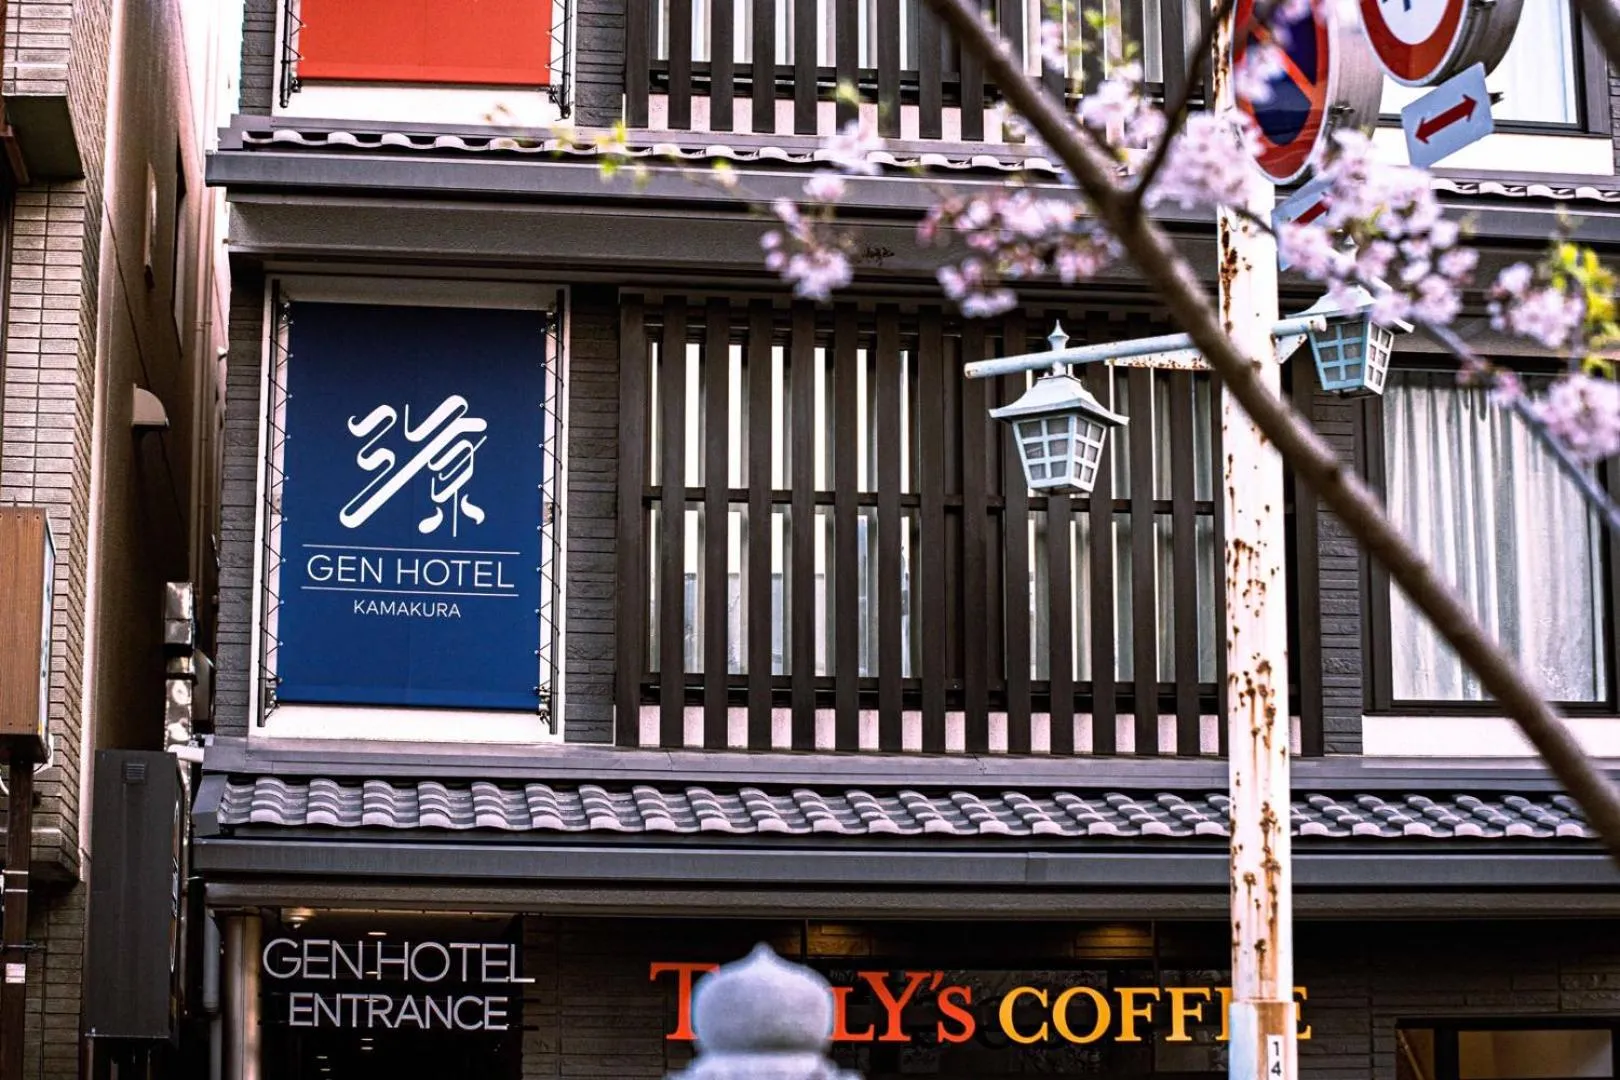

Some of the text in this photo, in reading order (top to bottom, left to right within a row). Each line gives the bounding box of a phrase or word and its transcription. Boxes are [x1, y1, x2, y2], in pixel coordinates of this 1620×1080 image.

[307, 554, 515, 588] GEN HOTEL
[353, 600, 461, 618] KAMAKURA
[262, 938, 536, 983] GEN HOTEL
[289, 992, 508, 1030] ENTRANCE
[650, 961, 976, 1043] TLY'S
